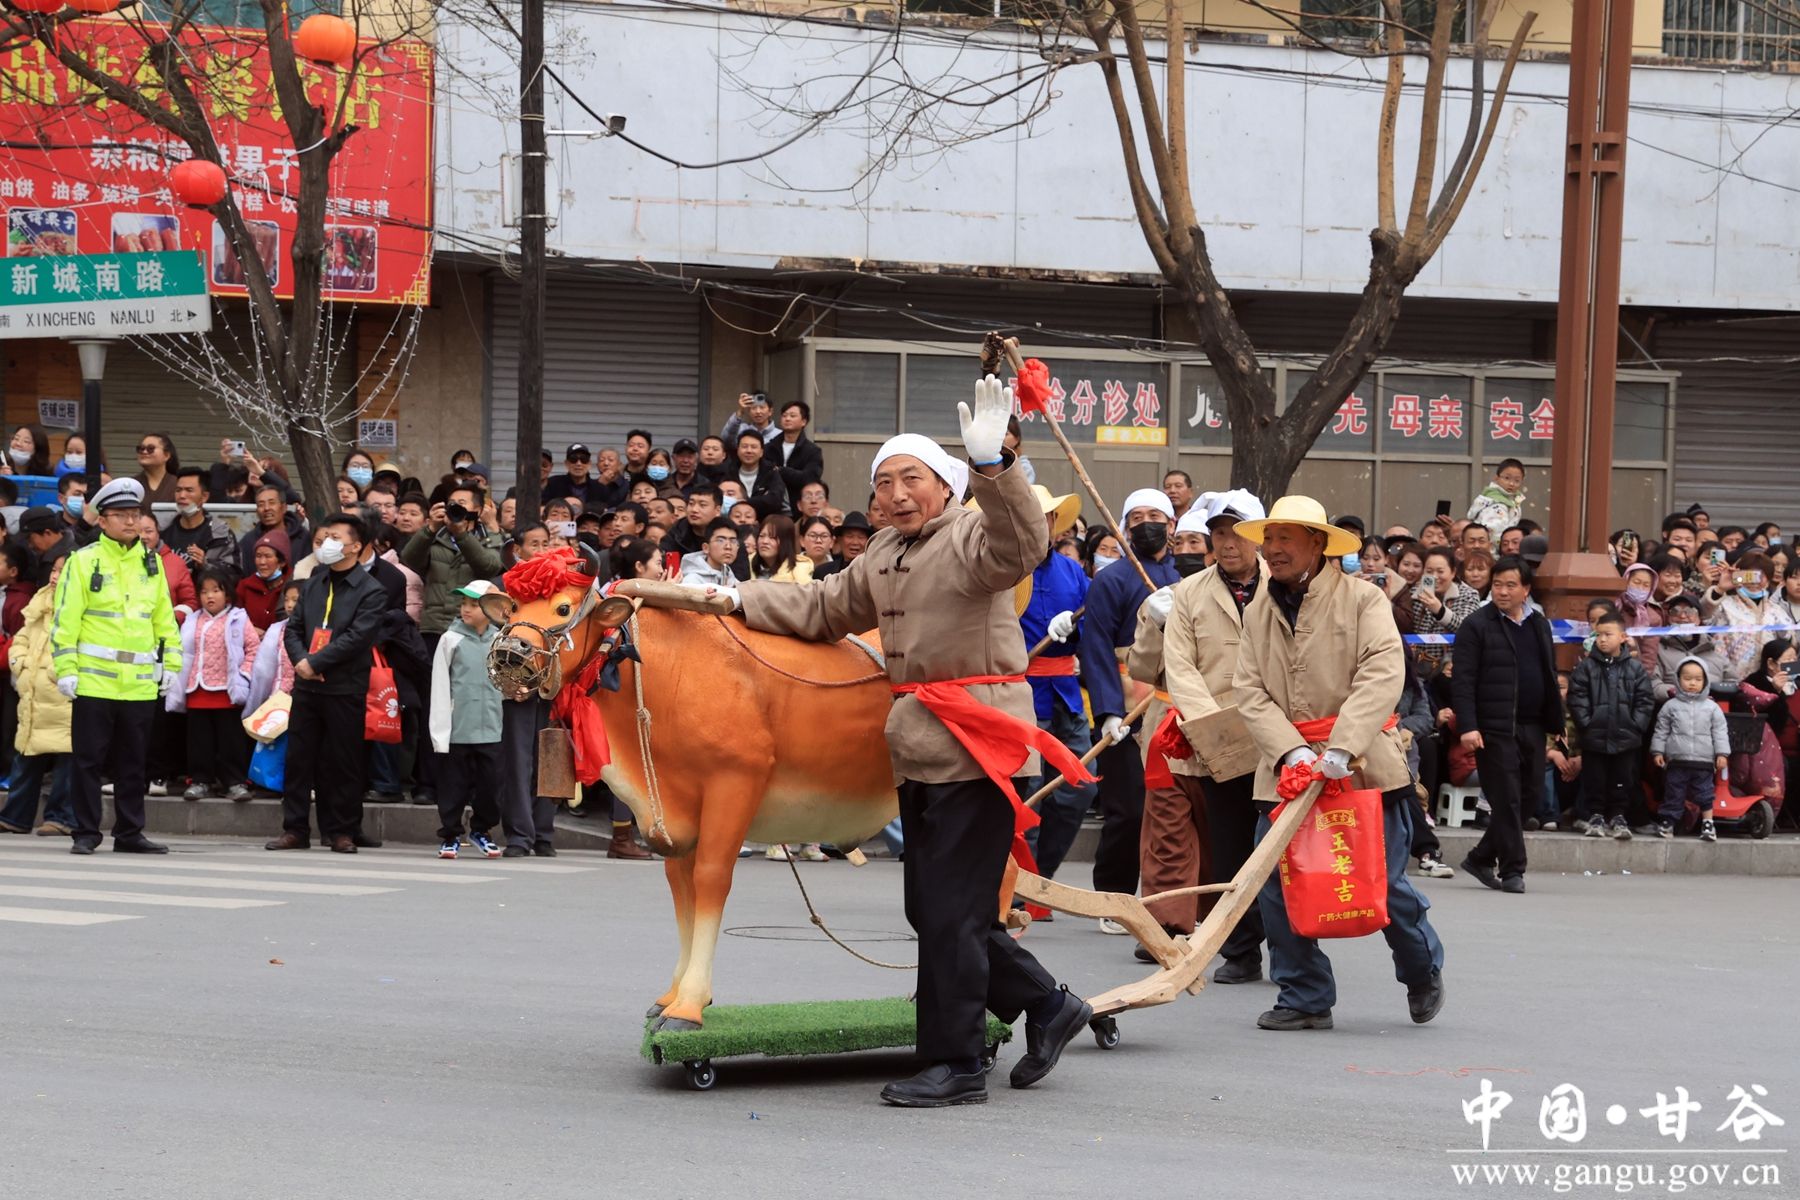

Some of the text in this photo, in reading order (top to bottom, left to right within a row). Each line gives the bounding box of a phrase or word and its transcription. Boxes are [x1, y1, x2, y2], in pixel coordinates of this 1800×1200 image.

[90, 135, 299, 180] 杂粮煎果子
[52, 181, 90, 201] 油条
[11, 259, 164, 296] 新城南路
[26, 311, 96, 327] XINCHENG
[111, 308, 155, 325] NANLU
[170, 309, 183, 322] 北
[1329, 831, 1356, 904] 王老吉
